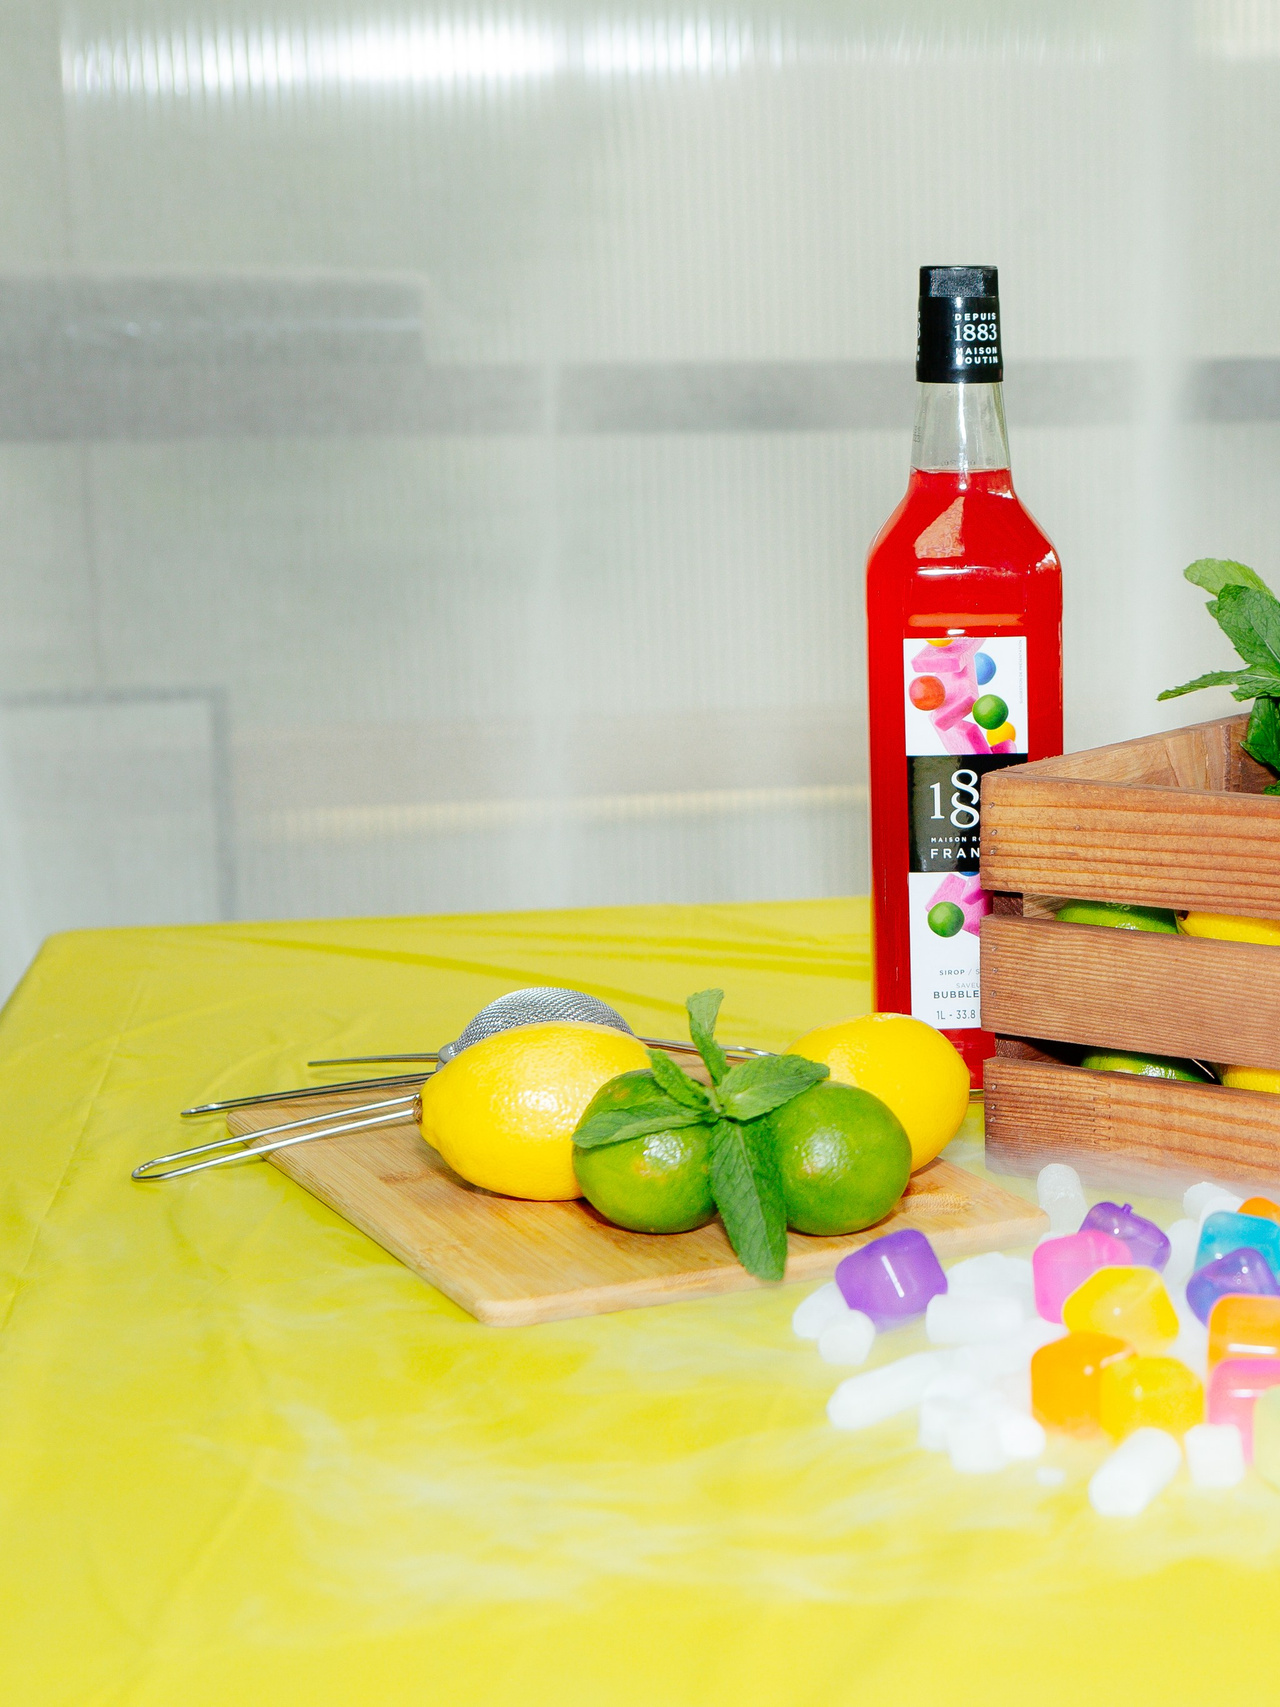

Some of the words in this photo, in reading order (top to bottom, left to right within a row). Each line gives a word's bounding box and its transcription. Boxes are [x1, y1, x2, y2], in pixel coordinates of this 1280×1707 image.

[954, 312, 997, 321] DEPUIS
[954, 323, 998, 342] 1883
[955, 346, 998, 355] MAISON
[933, 989, 980, 999] BUBBLE
[936, 1010, 946, 1020] 1L
[956, 1009, 976, 1020] 33.8
